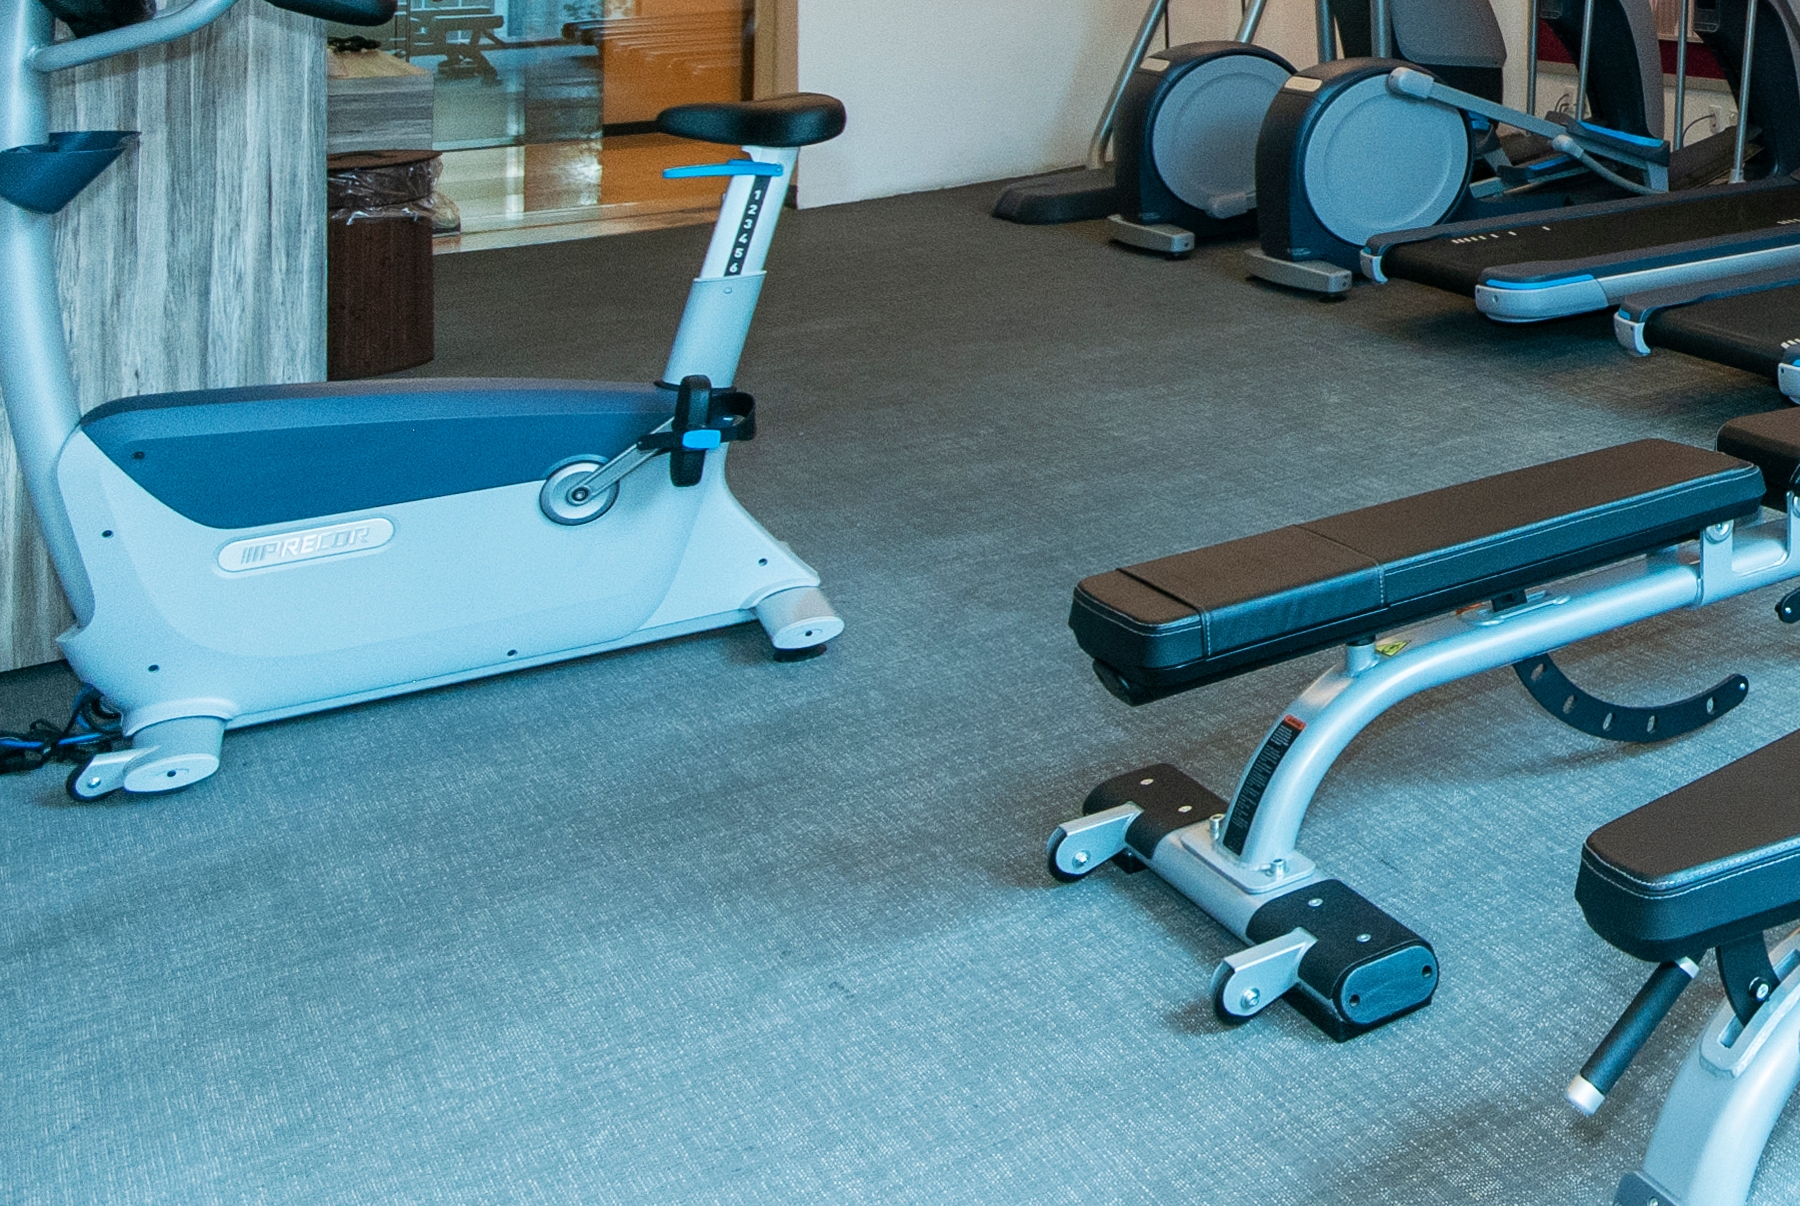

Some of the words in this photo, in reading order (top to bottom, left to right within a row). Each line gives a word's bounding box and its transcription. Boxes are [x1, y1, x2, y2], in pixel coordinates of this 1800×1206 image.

[754, 190, 762, 200] 1
[747, 204, 758, 215] 2
[743, 218, 753, 229] 3
[738, 233, 748, 244] 4
[734, 247, 744, 258] 5
[729, 262, 739, 273] 6
[256, 527, 370, 561] PRECOR
